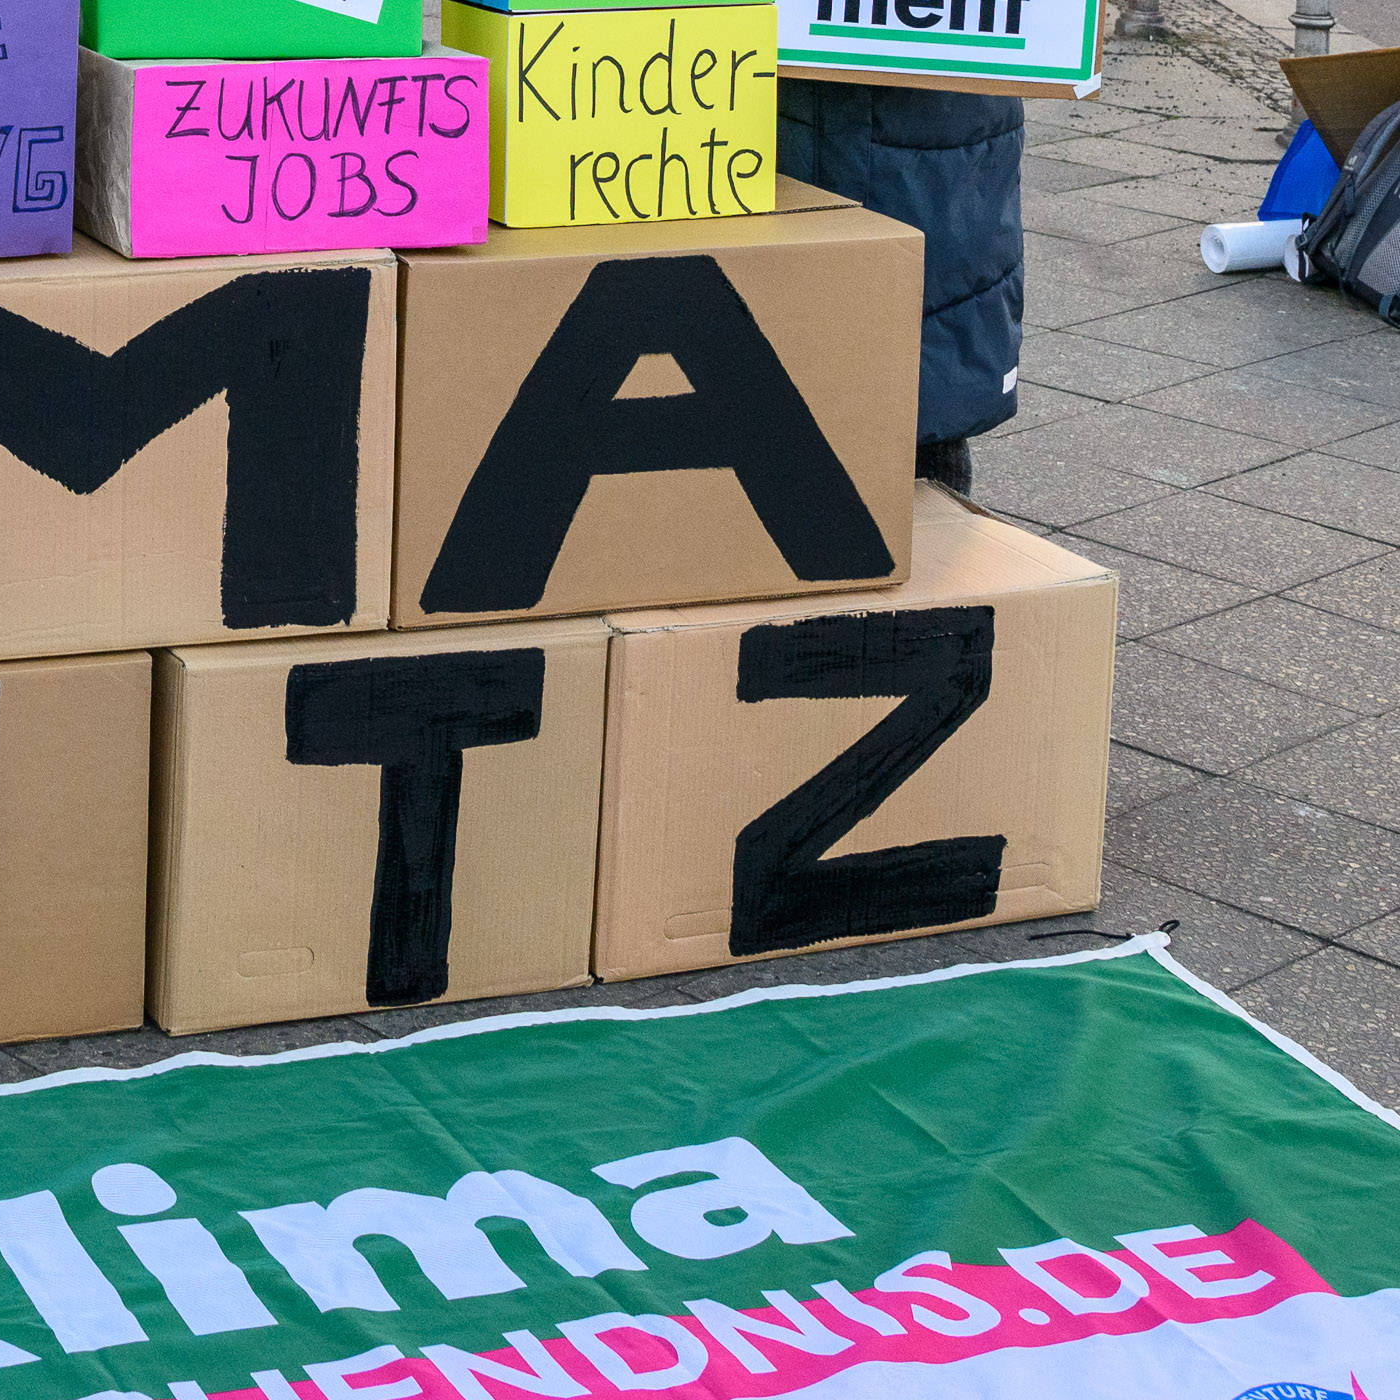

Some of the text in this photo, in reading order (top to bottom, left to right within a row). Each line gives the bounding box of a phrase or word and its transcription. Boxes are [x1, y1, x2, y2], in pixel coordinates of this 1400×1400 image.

[166, 74, 479, 141] ZUKUNFTS
[519, 19, 777, 124] Kinder-
[221, 151, 419, 223] JOBS
[570, 128, 762, 220] rechte
